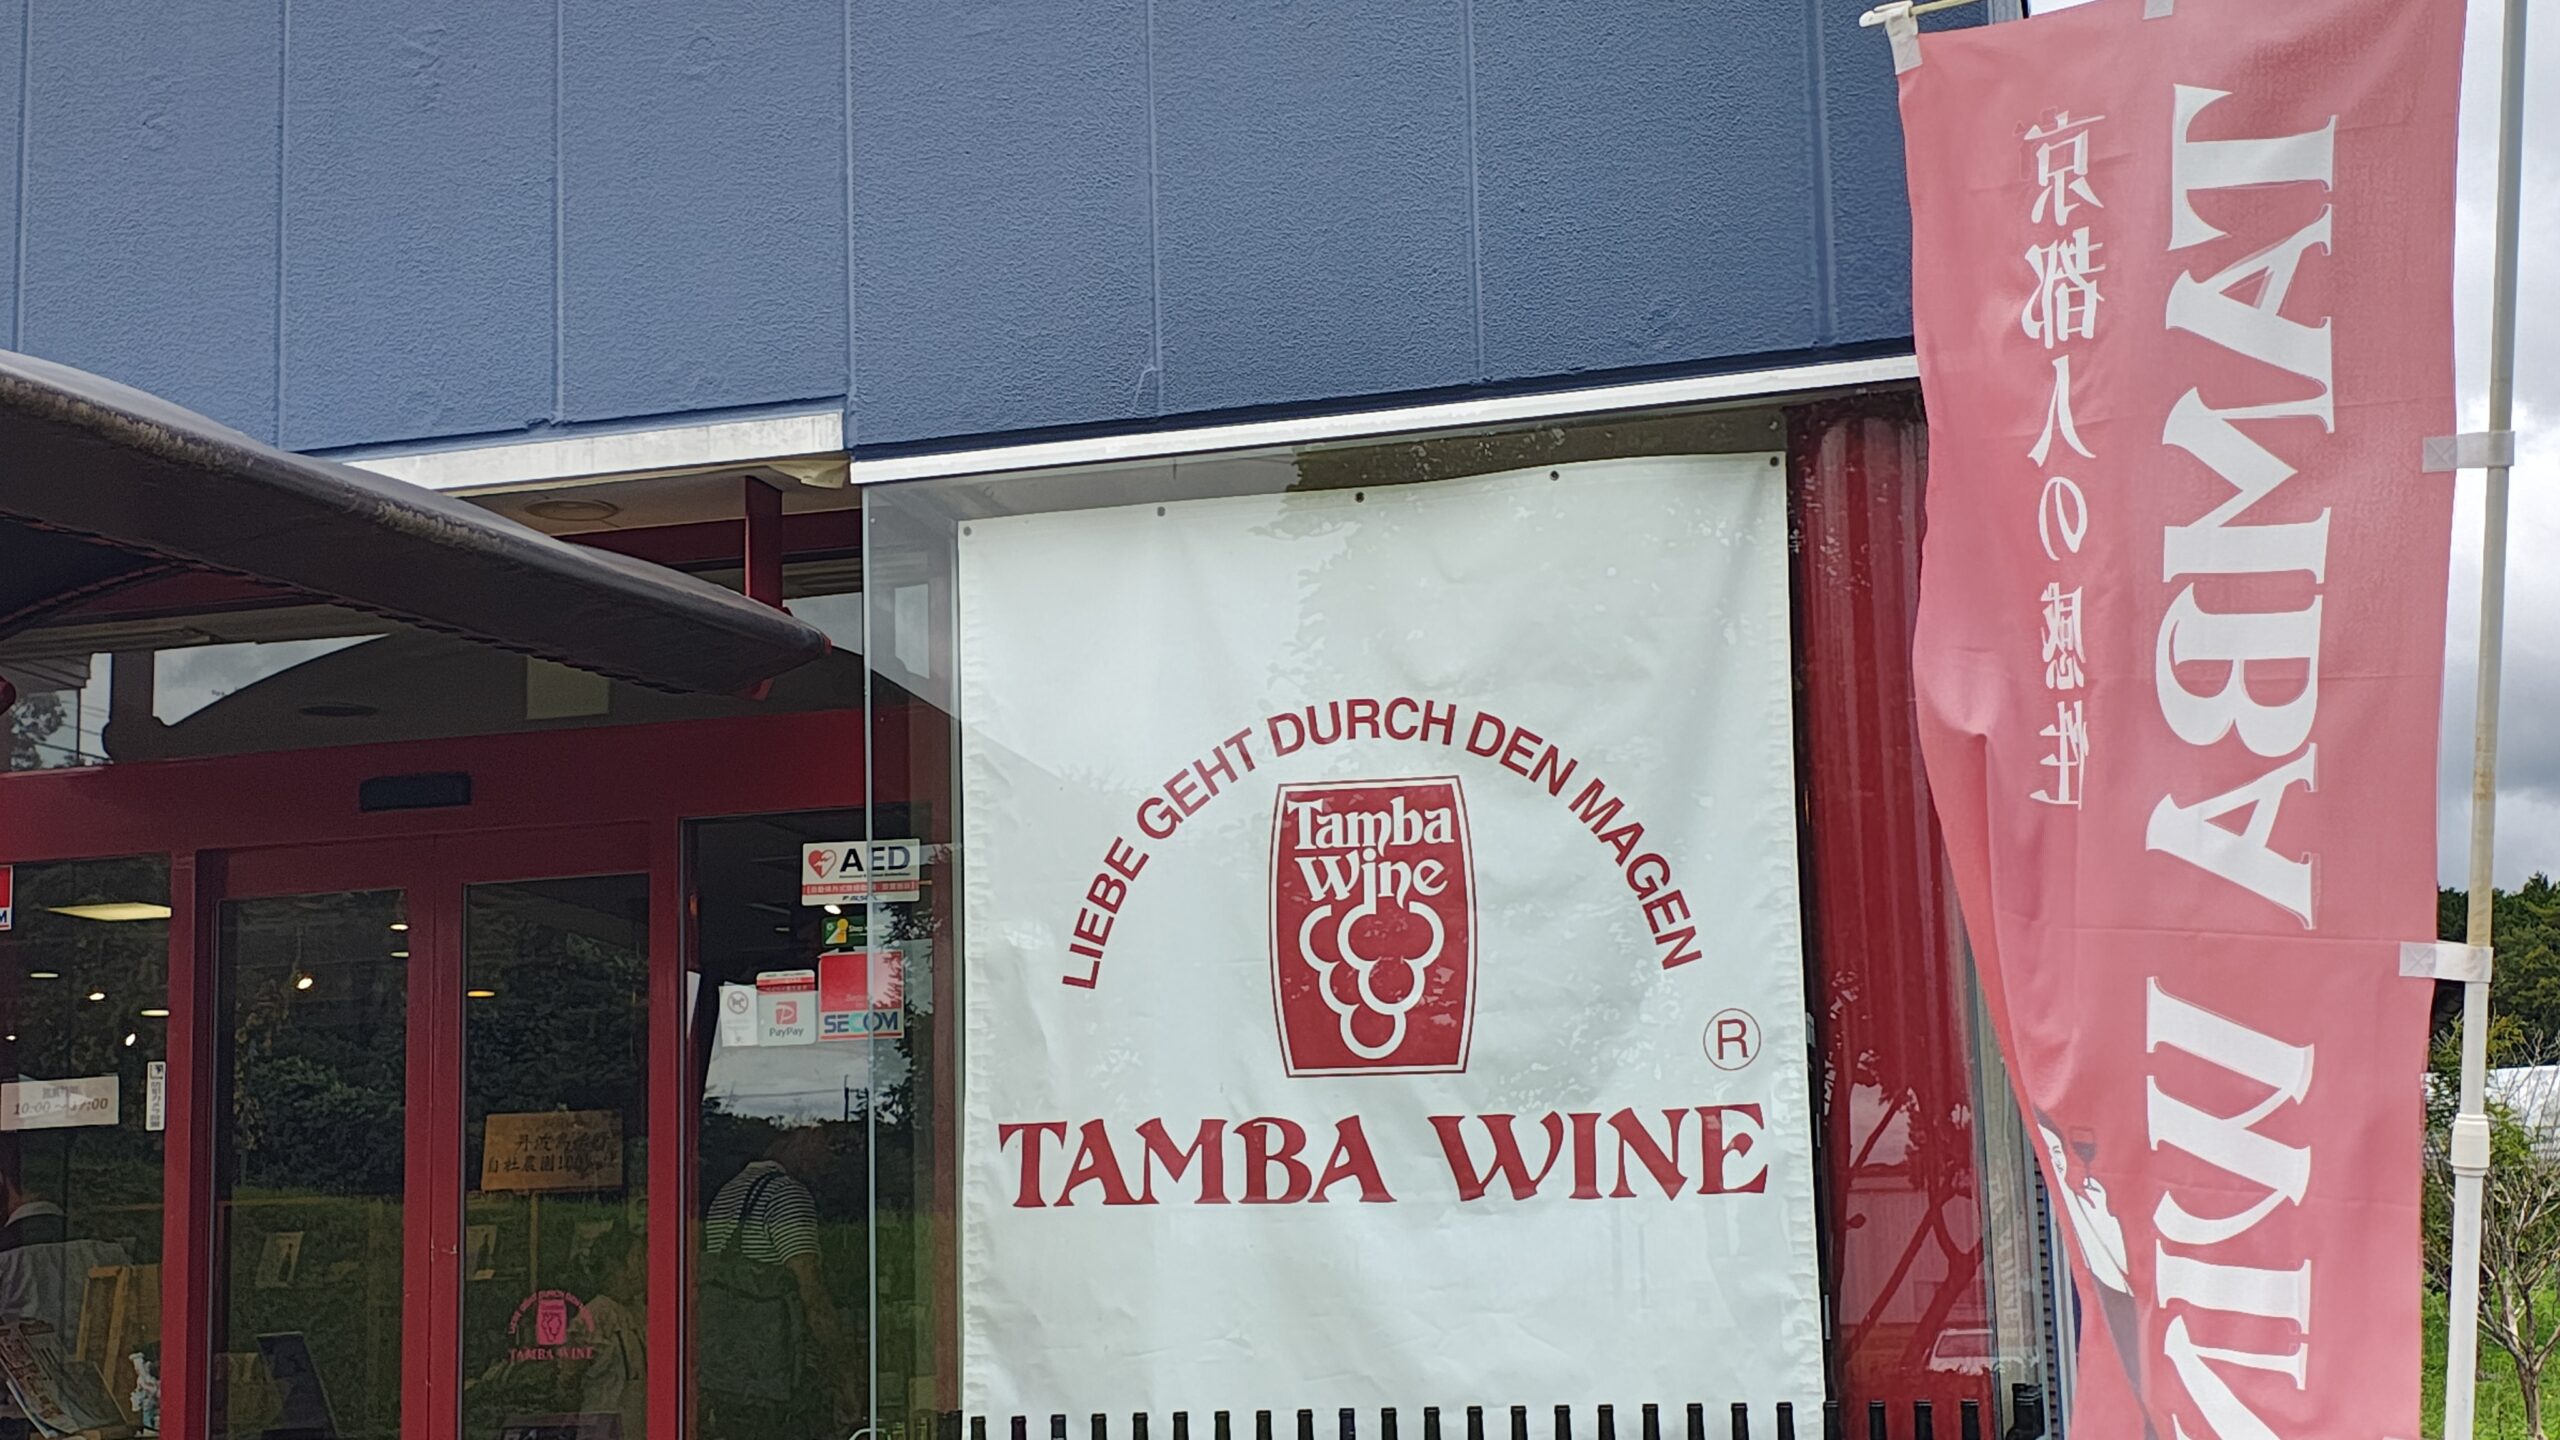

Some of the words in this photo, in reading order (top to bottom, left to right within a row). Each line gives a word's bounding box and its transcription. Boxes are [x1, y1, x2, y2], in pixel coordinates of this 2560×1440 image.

[1062, 838, 1150, 989] LIEBE
[1136, 730, 1254, 840] GEHT
[1268, 697, 1457, 756] DURCH
[1466, 711, 1577, 796] DEN
[1569, 778, 1702, 970] MAGEN
[1287, 796, 1454, 856] Tamba
[840, 846, 910, 872] AED
[1294, 848, 1448, 908] Wine
[769, 1026, 804, 1038] PayPay
[824, 1012, 898, 1034] SECOM
[999, 1115, 1393, 1208] TAMBA
[1430, 1103, 1767, 1201] WINE
